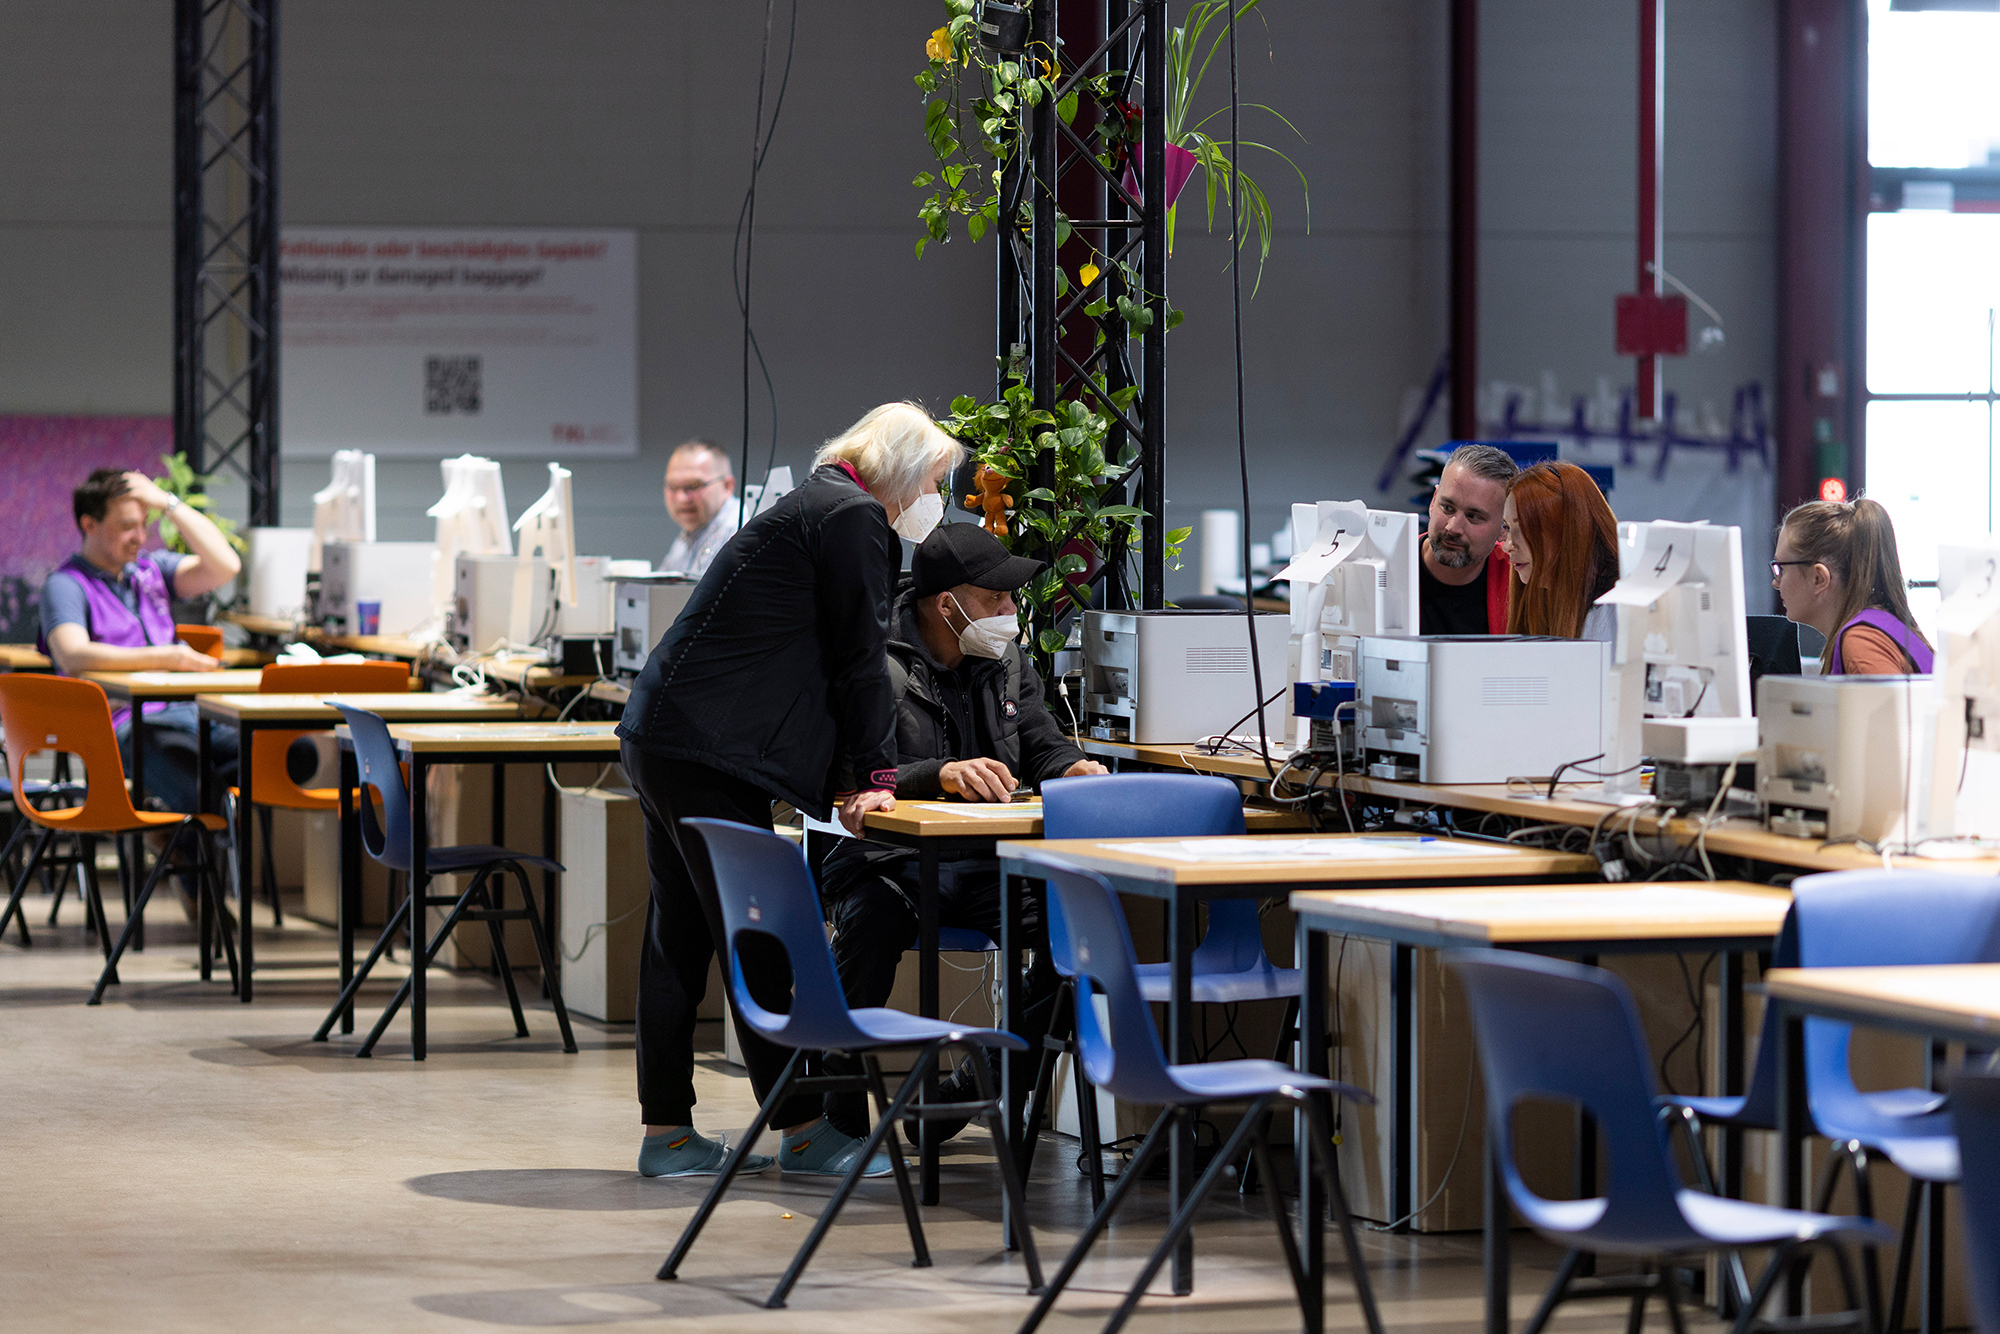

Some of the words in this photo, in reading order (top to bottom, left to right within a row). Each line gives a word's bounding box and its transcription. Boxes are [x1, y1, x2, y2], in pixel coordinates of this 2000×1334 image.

[375, 266, 456, 288] damaged
[1320, 529, 1346, 557] 5
[1653, 543, 1673, 577] 4
[1976, 558, 1996, 598] 3
